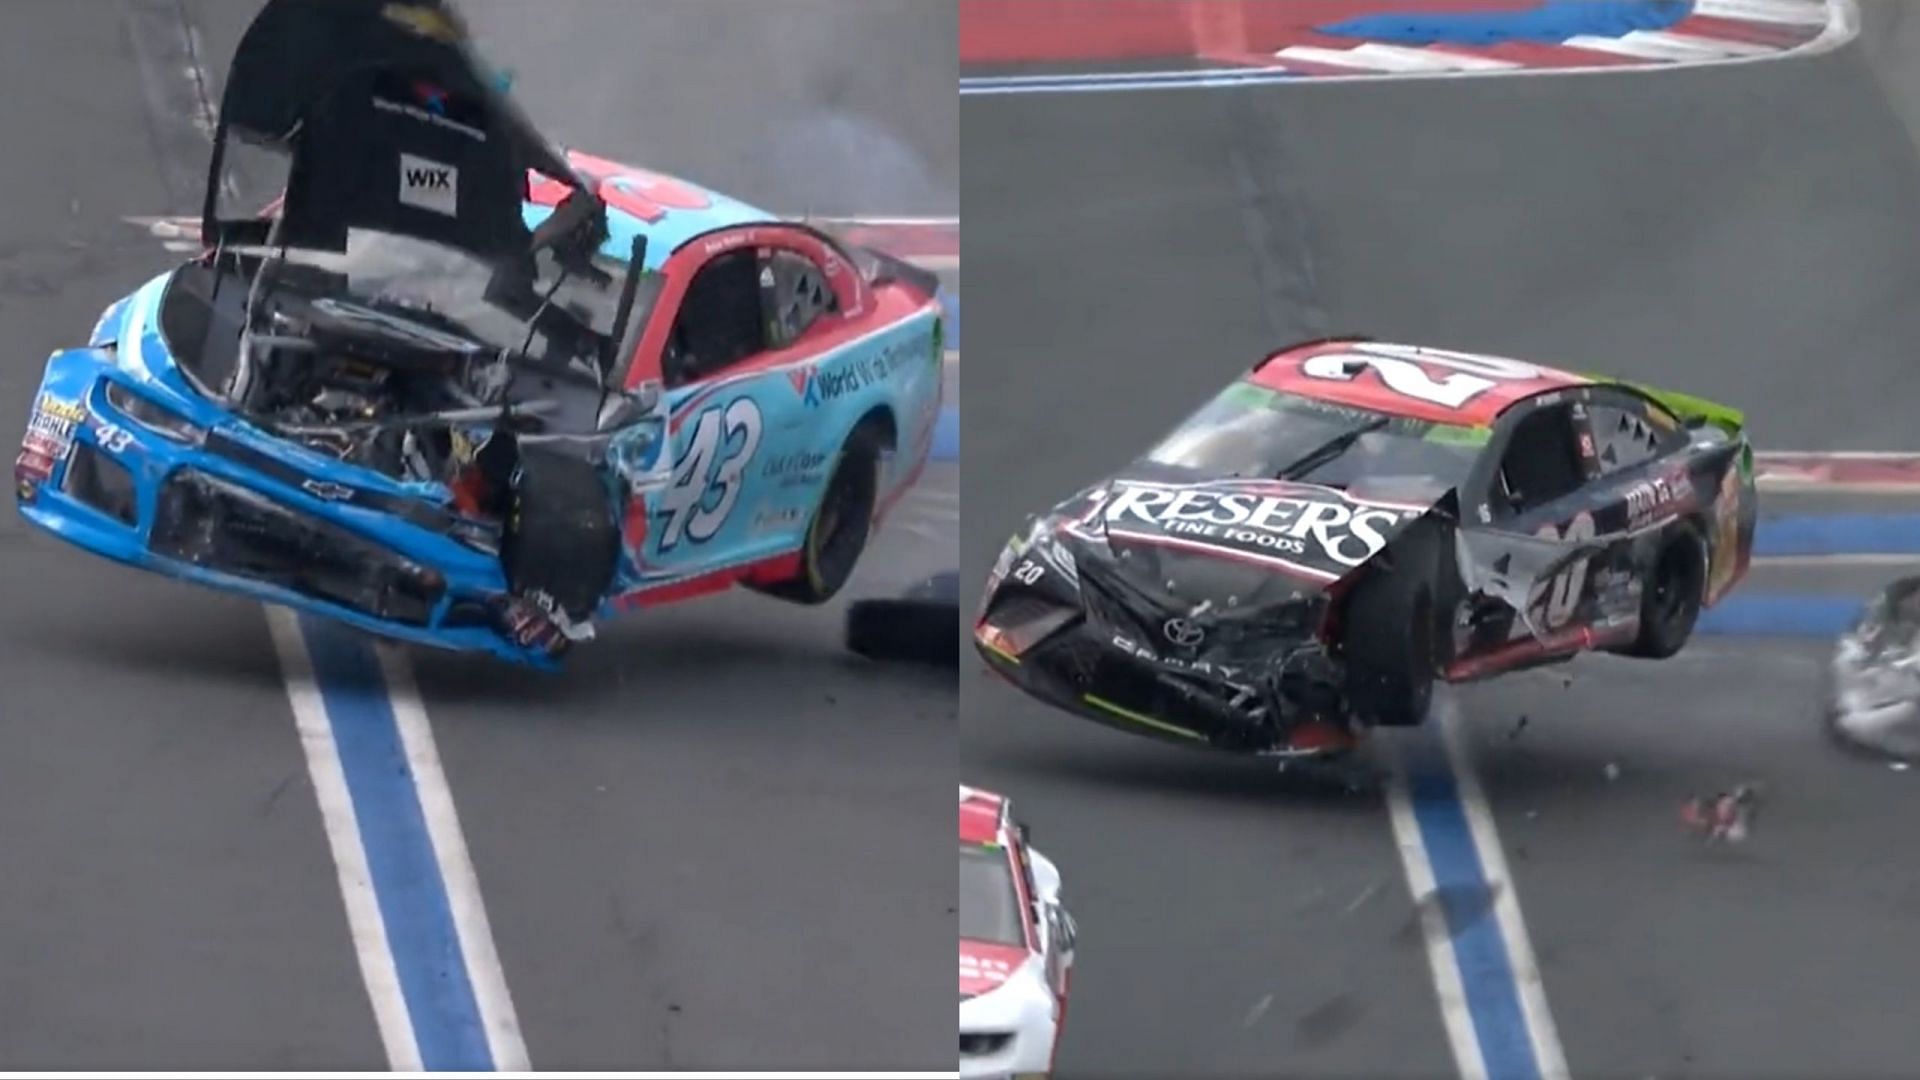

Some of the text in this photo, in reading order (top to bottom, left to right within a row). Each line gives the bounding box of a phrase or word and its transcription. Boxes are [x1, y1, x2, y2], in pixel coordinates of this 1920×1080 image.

[406, 168, 450, 189] WIX
[817, 361, 860, 401] World
[96, 424, 134, 453] 43
[657, 394, 763, 555] 43
[1104, 485, 1398, 567] RESER'S
[1165, 519, 1306, 554] FINE FOODS
[1014, 558, 1046, 587] 20
